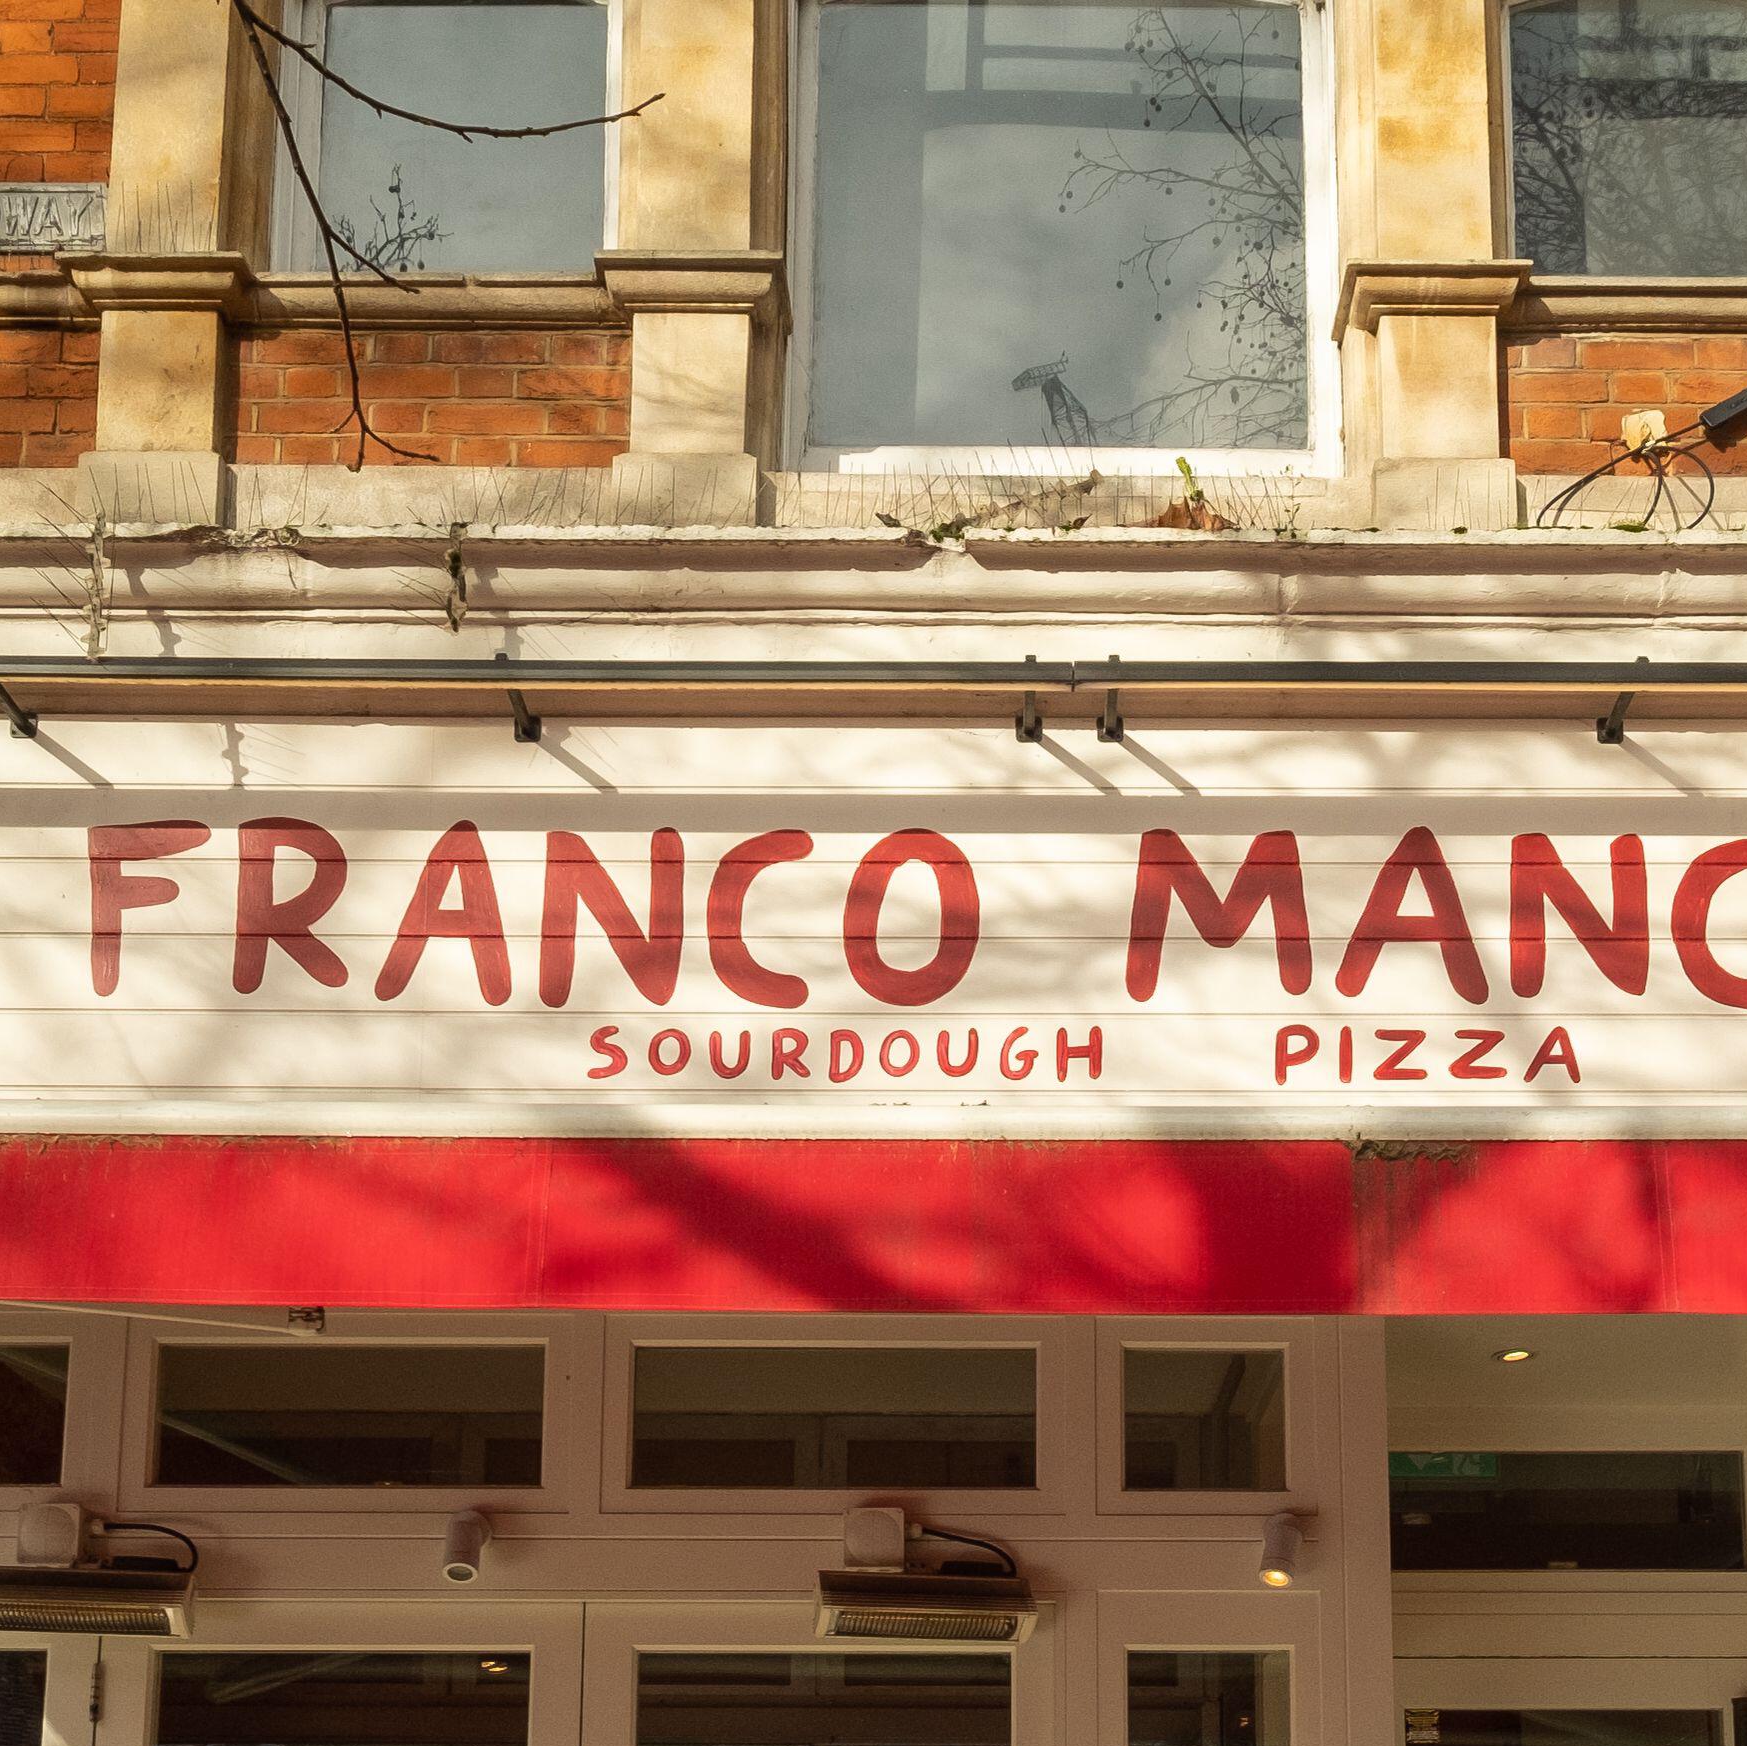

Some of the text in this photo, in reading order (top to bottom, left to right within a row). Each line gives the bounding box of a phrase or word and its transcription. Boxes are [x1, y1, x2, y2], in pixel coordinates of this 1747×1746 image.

[87, 816, 981, 1009] FRANCO
[586, 1024, 1581, 1085] SOURDOUGH PIZZA
